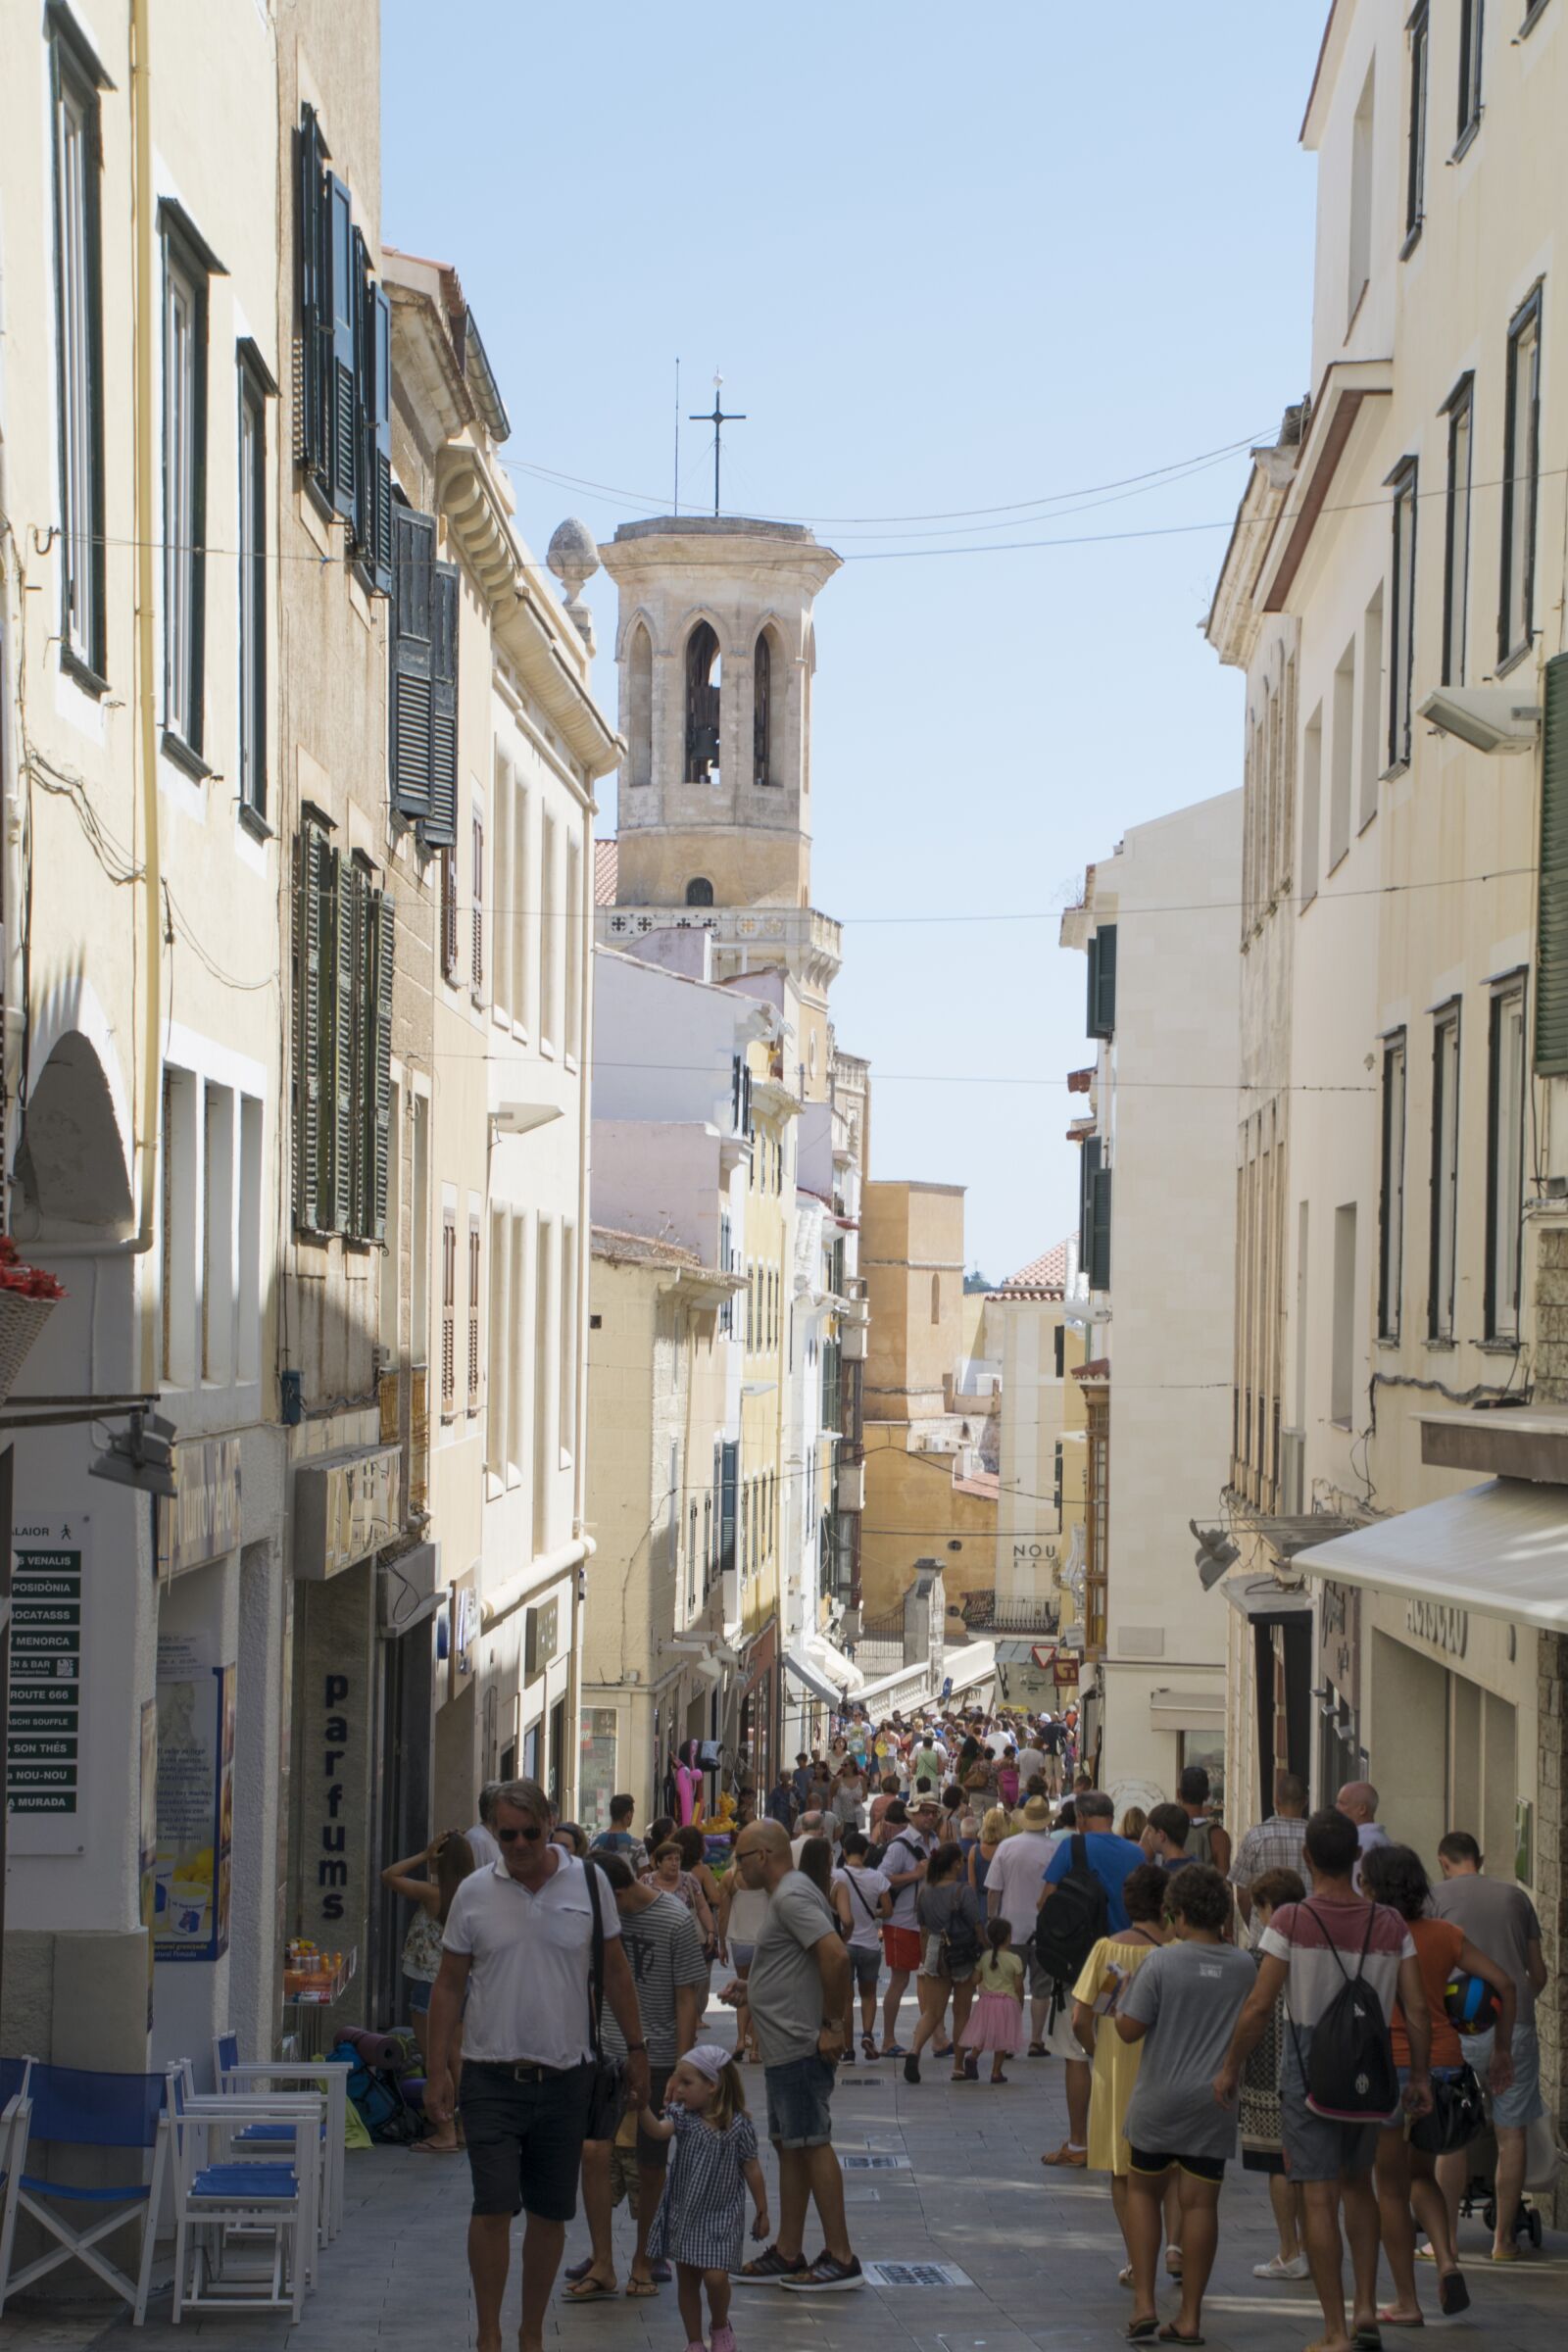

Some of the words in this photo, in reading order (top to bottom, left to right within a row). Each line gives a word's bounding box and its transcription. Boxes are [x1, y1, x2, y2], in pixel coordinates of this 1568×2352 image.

[12, 1527, 50, 1537] LAIOR
[1013, 1544, 1055, 1558] NOU
[27, 1556, 72, 1566] VENALIS
[13, 1580, 71, 1592] POSIDÒNIA
[16, 1637, 70, 1646] MENORCA
[22, 1660, 28, 1669] &
[30, 1660, 51, 1669] BAR
[10, 1690, 46, 1699] ROUTE
[48, 1690, 70, 1699] 666
[14, 1743, 36, 1753] SON
[39, 1741, 68, 1753] THÉS
[16, 1771, 68, 1780] NOU-NOU
[18, 1797, 66, 1807] MURADA
[318, 1674, 349, 1921] parfums
